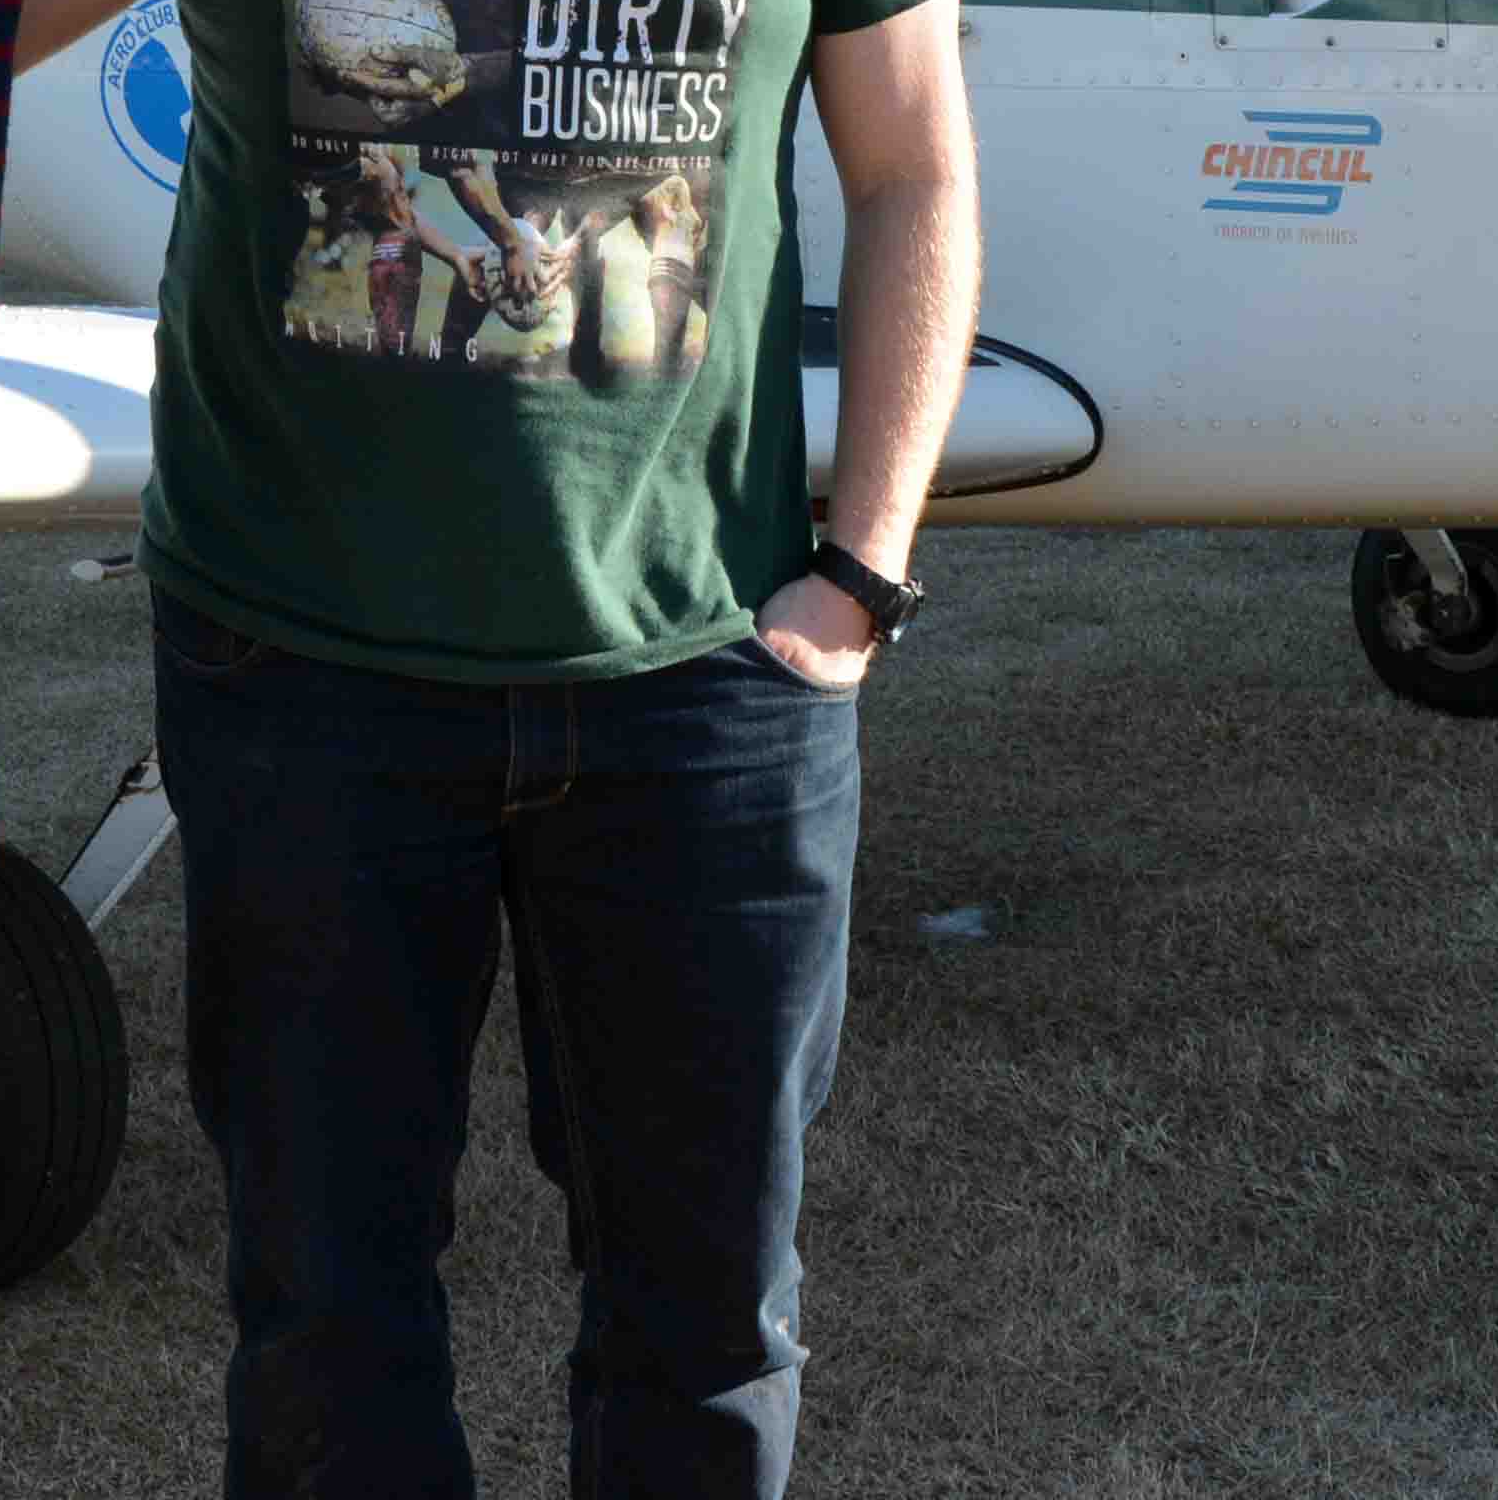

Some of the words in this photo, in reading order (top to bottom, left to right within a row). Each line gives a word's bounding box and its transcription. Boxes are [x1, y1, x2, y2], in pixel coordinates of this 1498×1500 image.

[108, 31, 136, 90] AERO
[135, 4, 174, 38] CLUB
[522, 63, 727, 144] BUSINESS
[316, 137, 349, 154] ONLY
[530, 151, 566, 167] WHAT
[1202, 143, 1374, 184] CHINCUL
